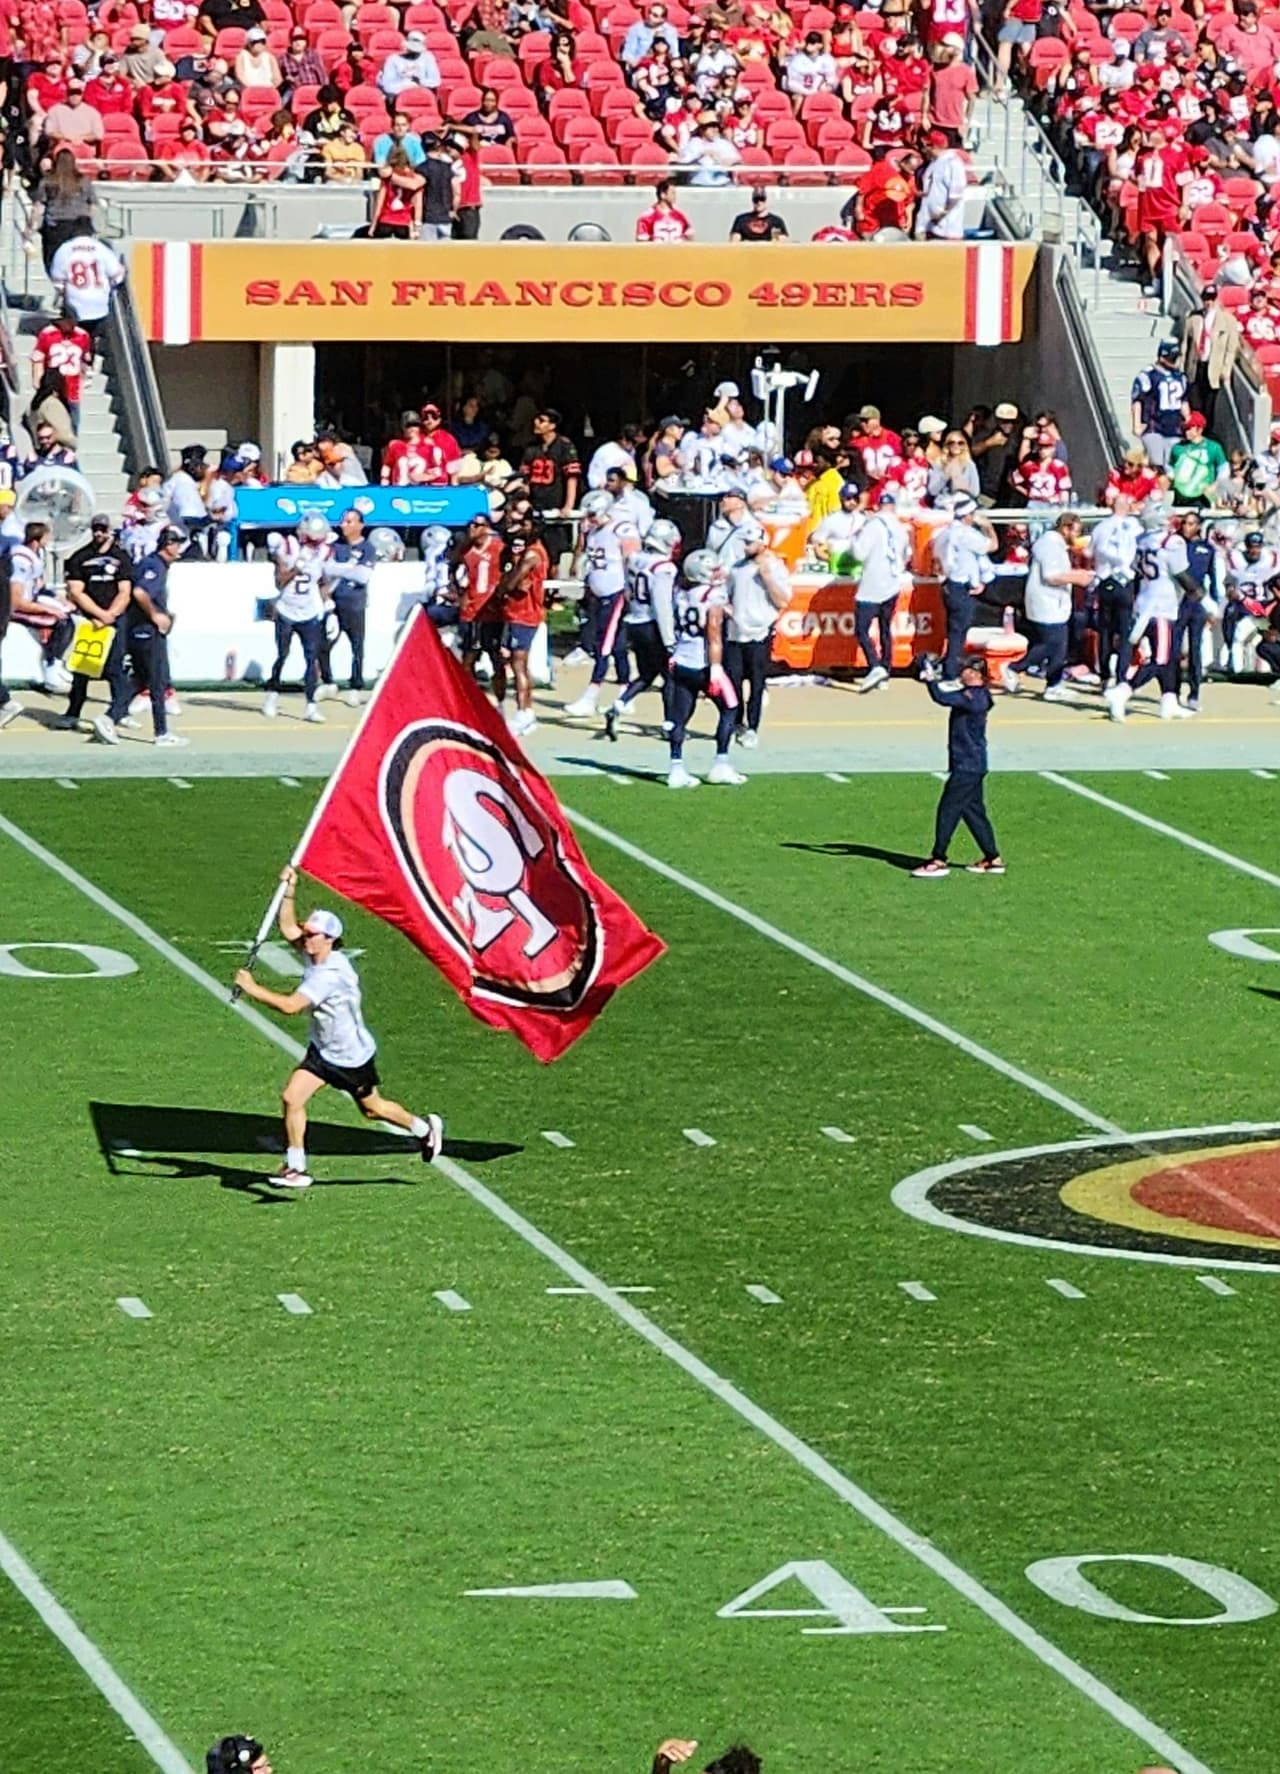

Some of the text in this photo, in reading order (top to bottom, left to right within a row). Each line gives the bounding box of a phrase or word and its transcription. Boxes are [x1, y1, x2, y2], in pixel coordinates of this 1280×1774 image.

[71, 261, 104, 289] 81
[245, 280, 926, 308] SAN FRANCISCO 49ERS
[50, 343, 84, 376] 23
[1157, 378, 1184, 410] 12
[476, 560, 489, 594] 1
[714, 1552, 1280, 1635] 40
